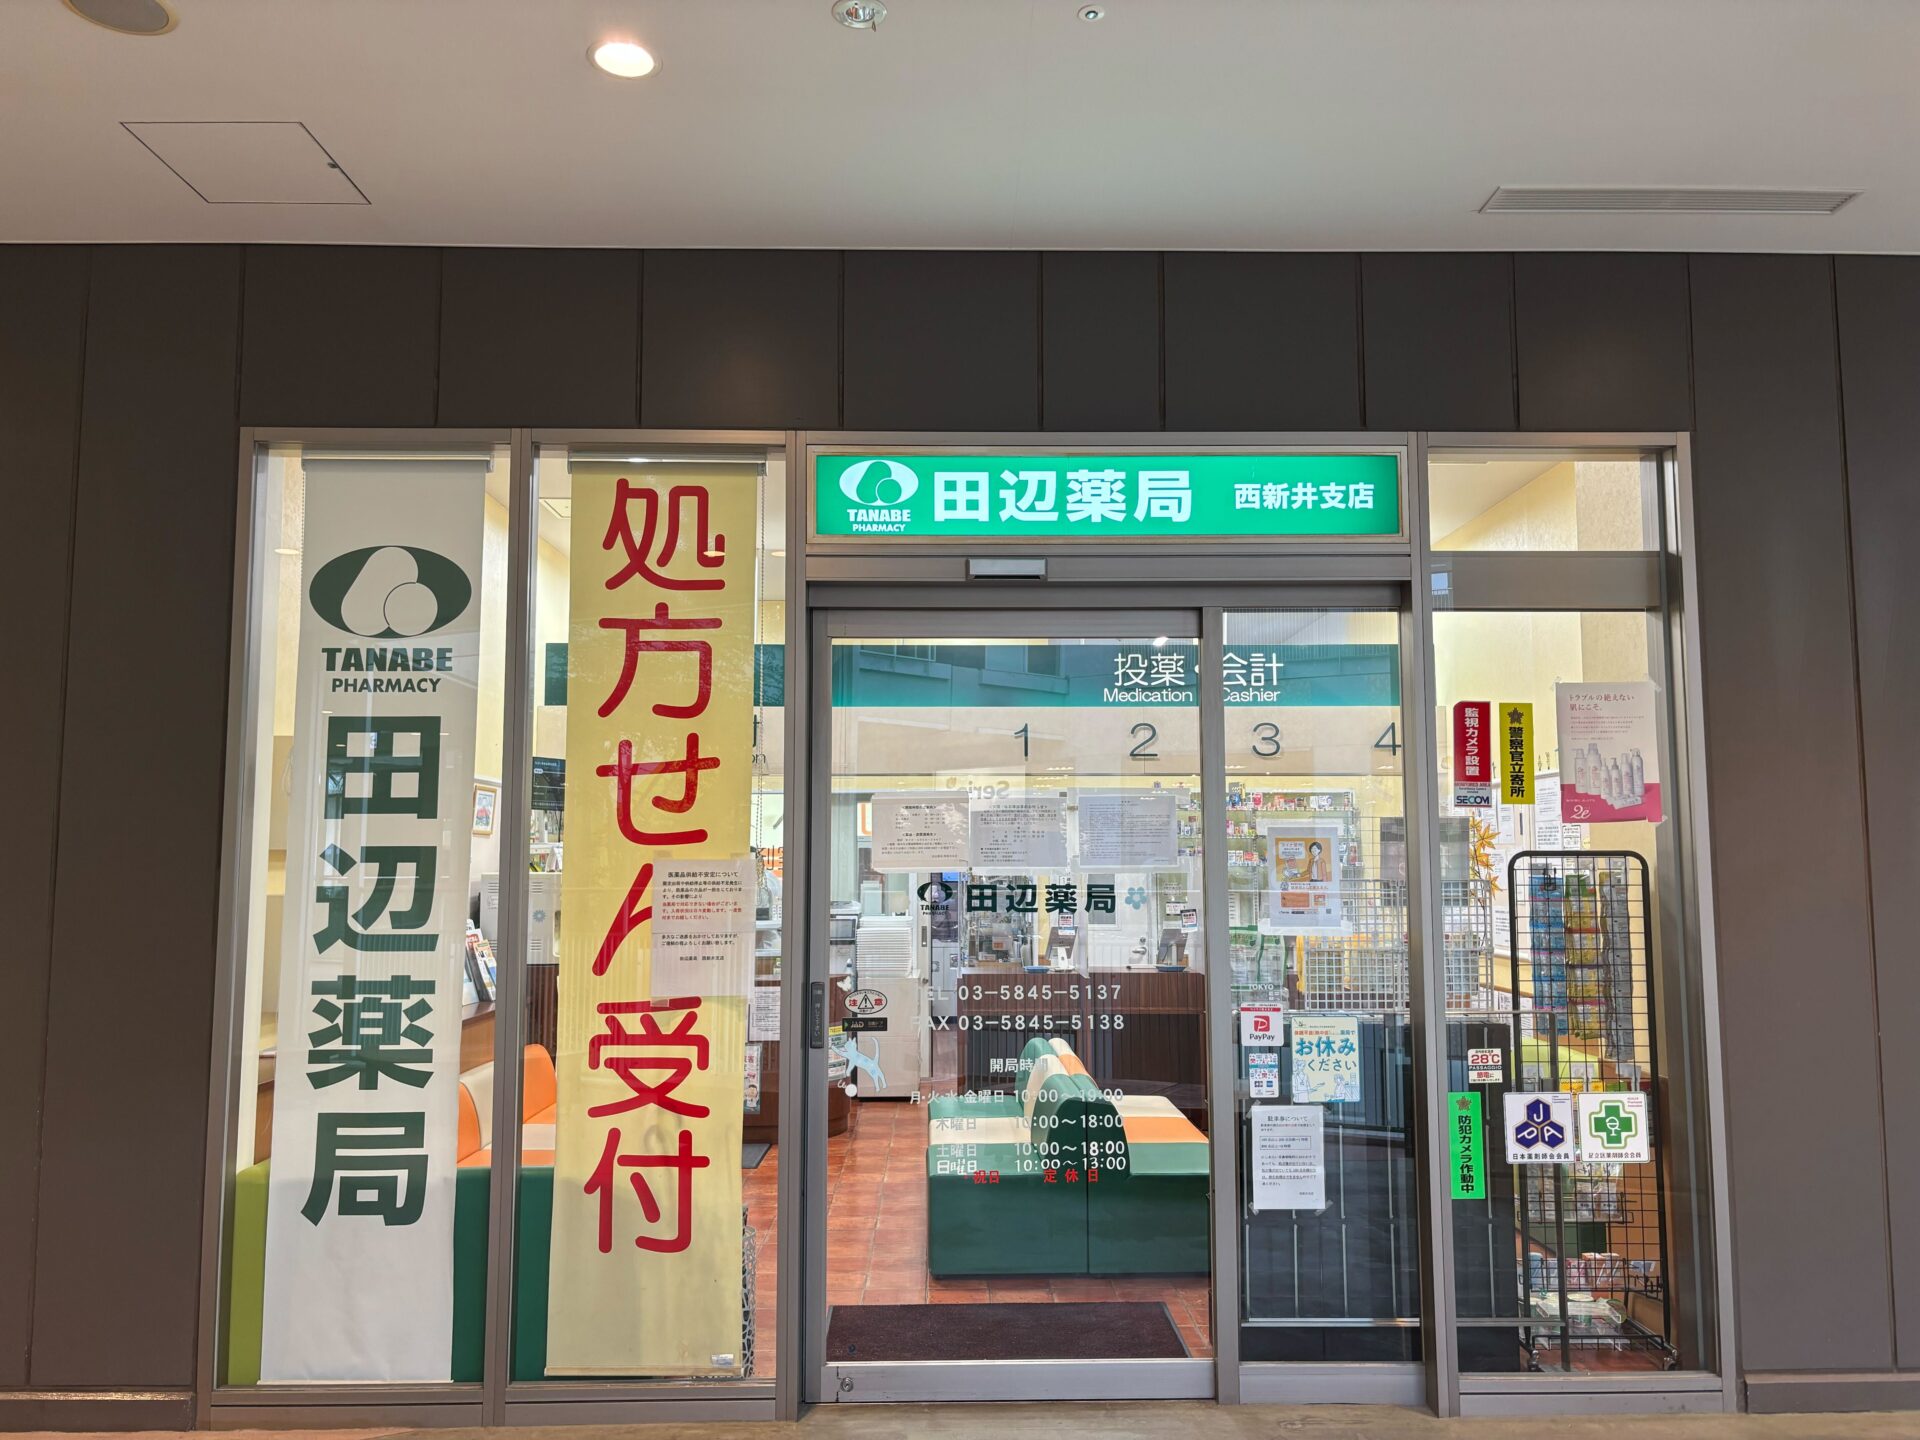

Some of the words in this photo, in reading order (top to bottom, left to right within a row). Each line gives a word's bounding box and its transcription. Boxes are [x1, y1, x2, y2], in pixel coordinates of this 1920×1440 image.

[934, 469, 1192, 523] 田辺薬局
[1234, 482, 1374, 509] 西新井支店
[847, 509, 911, 523] TANABE
[852, 523, 906, 533] PHARMACY
[322, 647, 453, 672] TANABE
[331, 678, 441, 693] PHARMACY
[1103, 687, 1193, 702] Medication
[1569, 693, 1634, 702] トラブルの絶えない
[1014, 722, 1029, 758] 1
[1129, 722, 1160, 758] 2
[1252, 722, 1282, 757] 3
[1374, 722, 1402, 757] 4
[1464, 707, 1480, 776] 監視カメラ設置
[1509, 727, 1525, 798] 警察官立寄所
[1456, 796, 1490, 805] SECOM
[966, 883, 1116, 914] 田辺薬局
[300, 716, 442, 1227] 田辺薬局
[958, 985, 1121, 1001] 03-5845-5137
[958, 1015, 1124, 1031] 03-5845-5138
[1249, 1033, 1275, 1042] PayPay
[1295, 1036, 1356, 1057] お休み
[1308, 1059, 1357, 1072] ください
[936, 1116, 977, 1131] 木曜日
[936, 1143, 977, 1158] 土曜日
[1458, 1115, 1475, 1194] 防犯カメラ作動中
[936, 1159, 978, 1175] 日曜日
